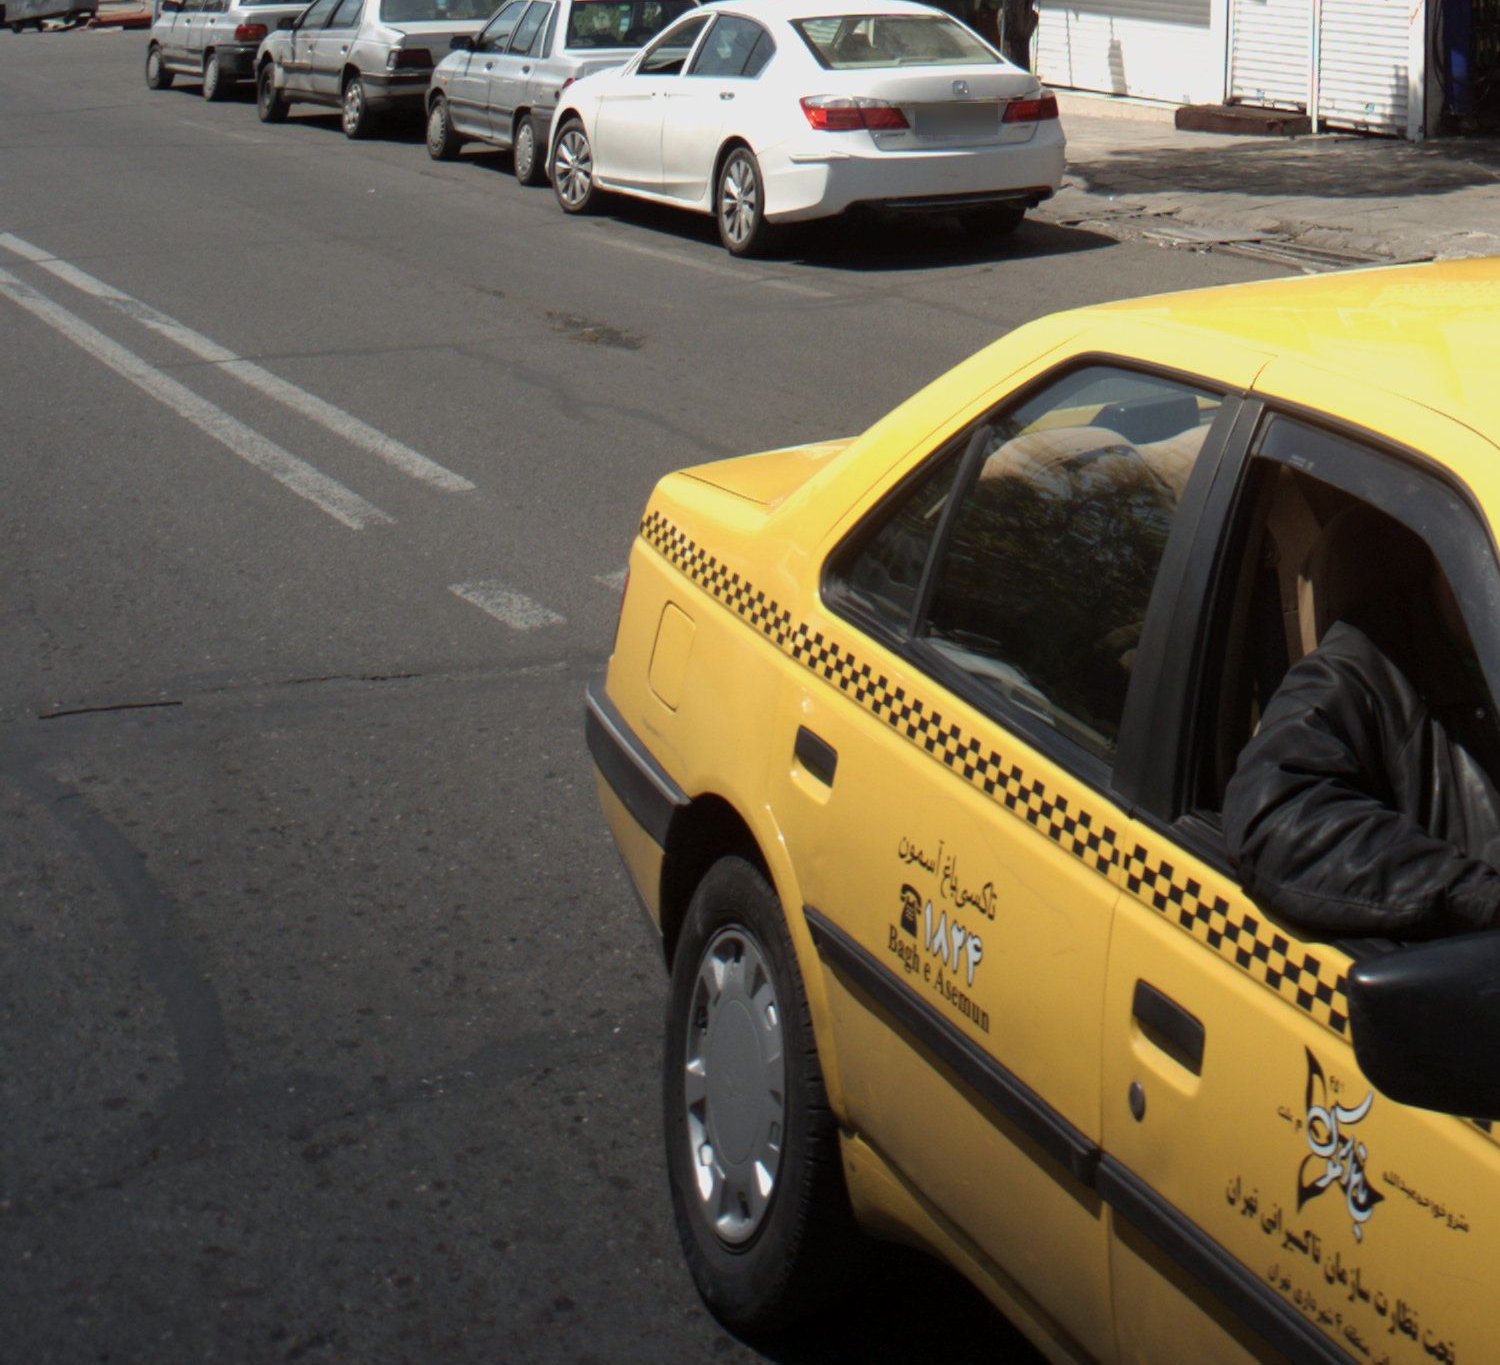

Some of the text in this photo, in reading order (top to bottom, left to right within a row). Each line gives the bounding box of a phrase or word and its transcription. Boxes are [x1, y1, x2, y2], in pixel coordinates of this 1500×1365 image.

[898, 836, 998, 920] تاکسی باغ آسمون
[887, 922, 990, 1035] Bagh e Asemun
